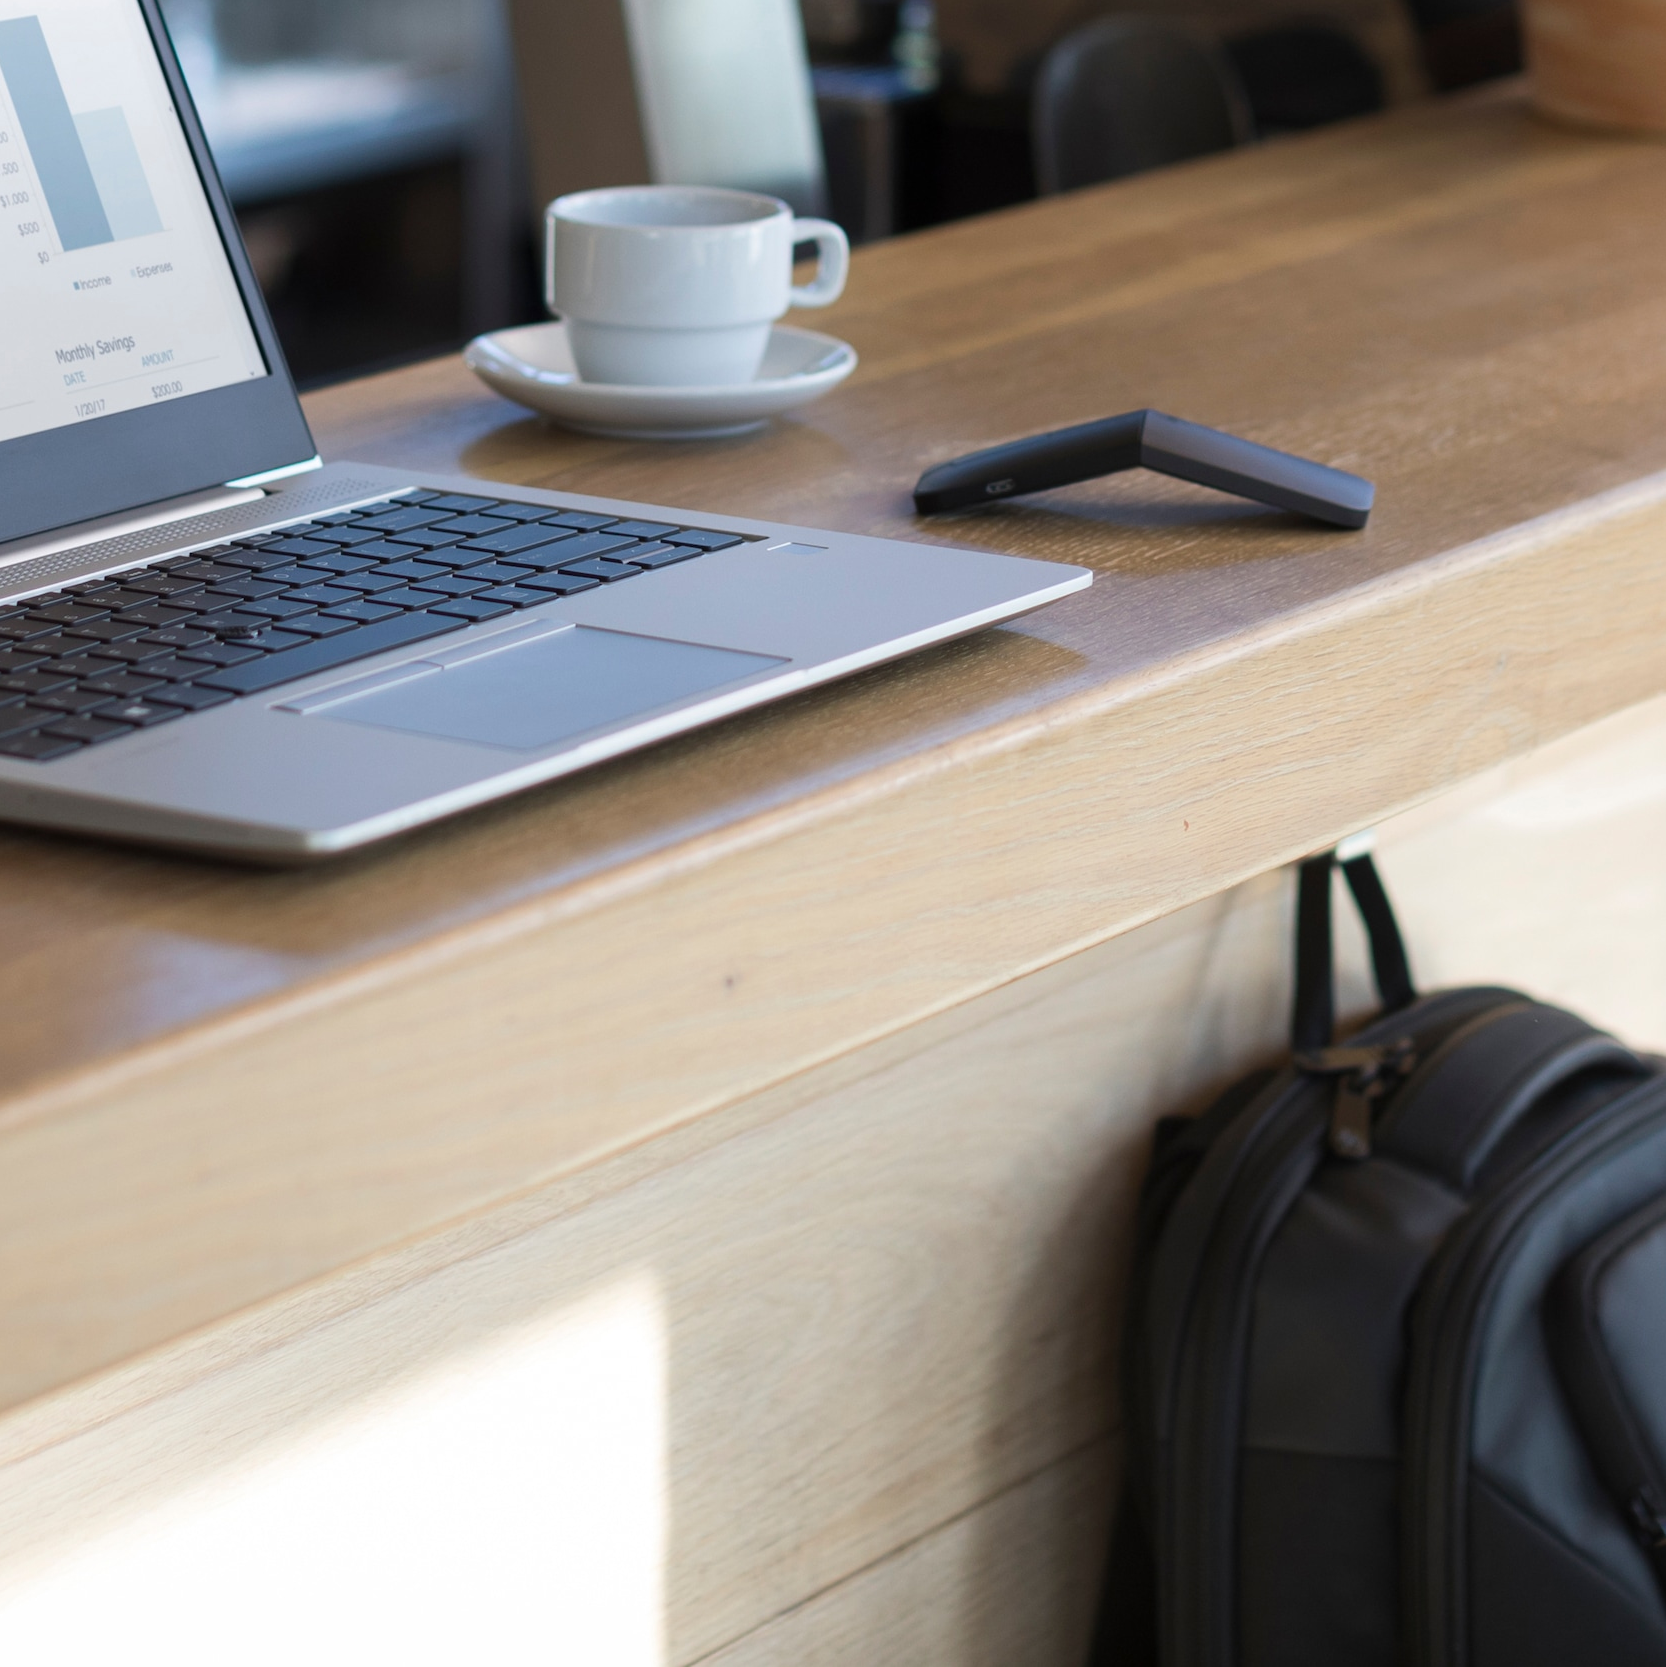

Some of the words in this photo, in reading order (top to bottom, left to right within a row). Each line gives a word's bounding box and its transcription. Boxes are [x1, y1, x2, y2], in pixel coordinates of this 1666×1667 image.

[18, 221, 40, 237] $500
[37, 251, 50, 265] $0
[136, 262, 173, 278] Expenses
[79, 276, 112, 290] Income
[55, 342, 96, 364] Monthly
[96, 335, 136, 356] Savings
[141, 349, 175, 367] AMOUNT
[63, 370, 87, 387] DATE
[151, 380, 183, 399] $200.00
[75, 399, 106, 417] 1/20/17
